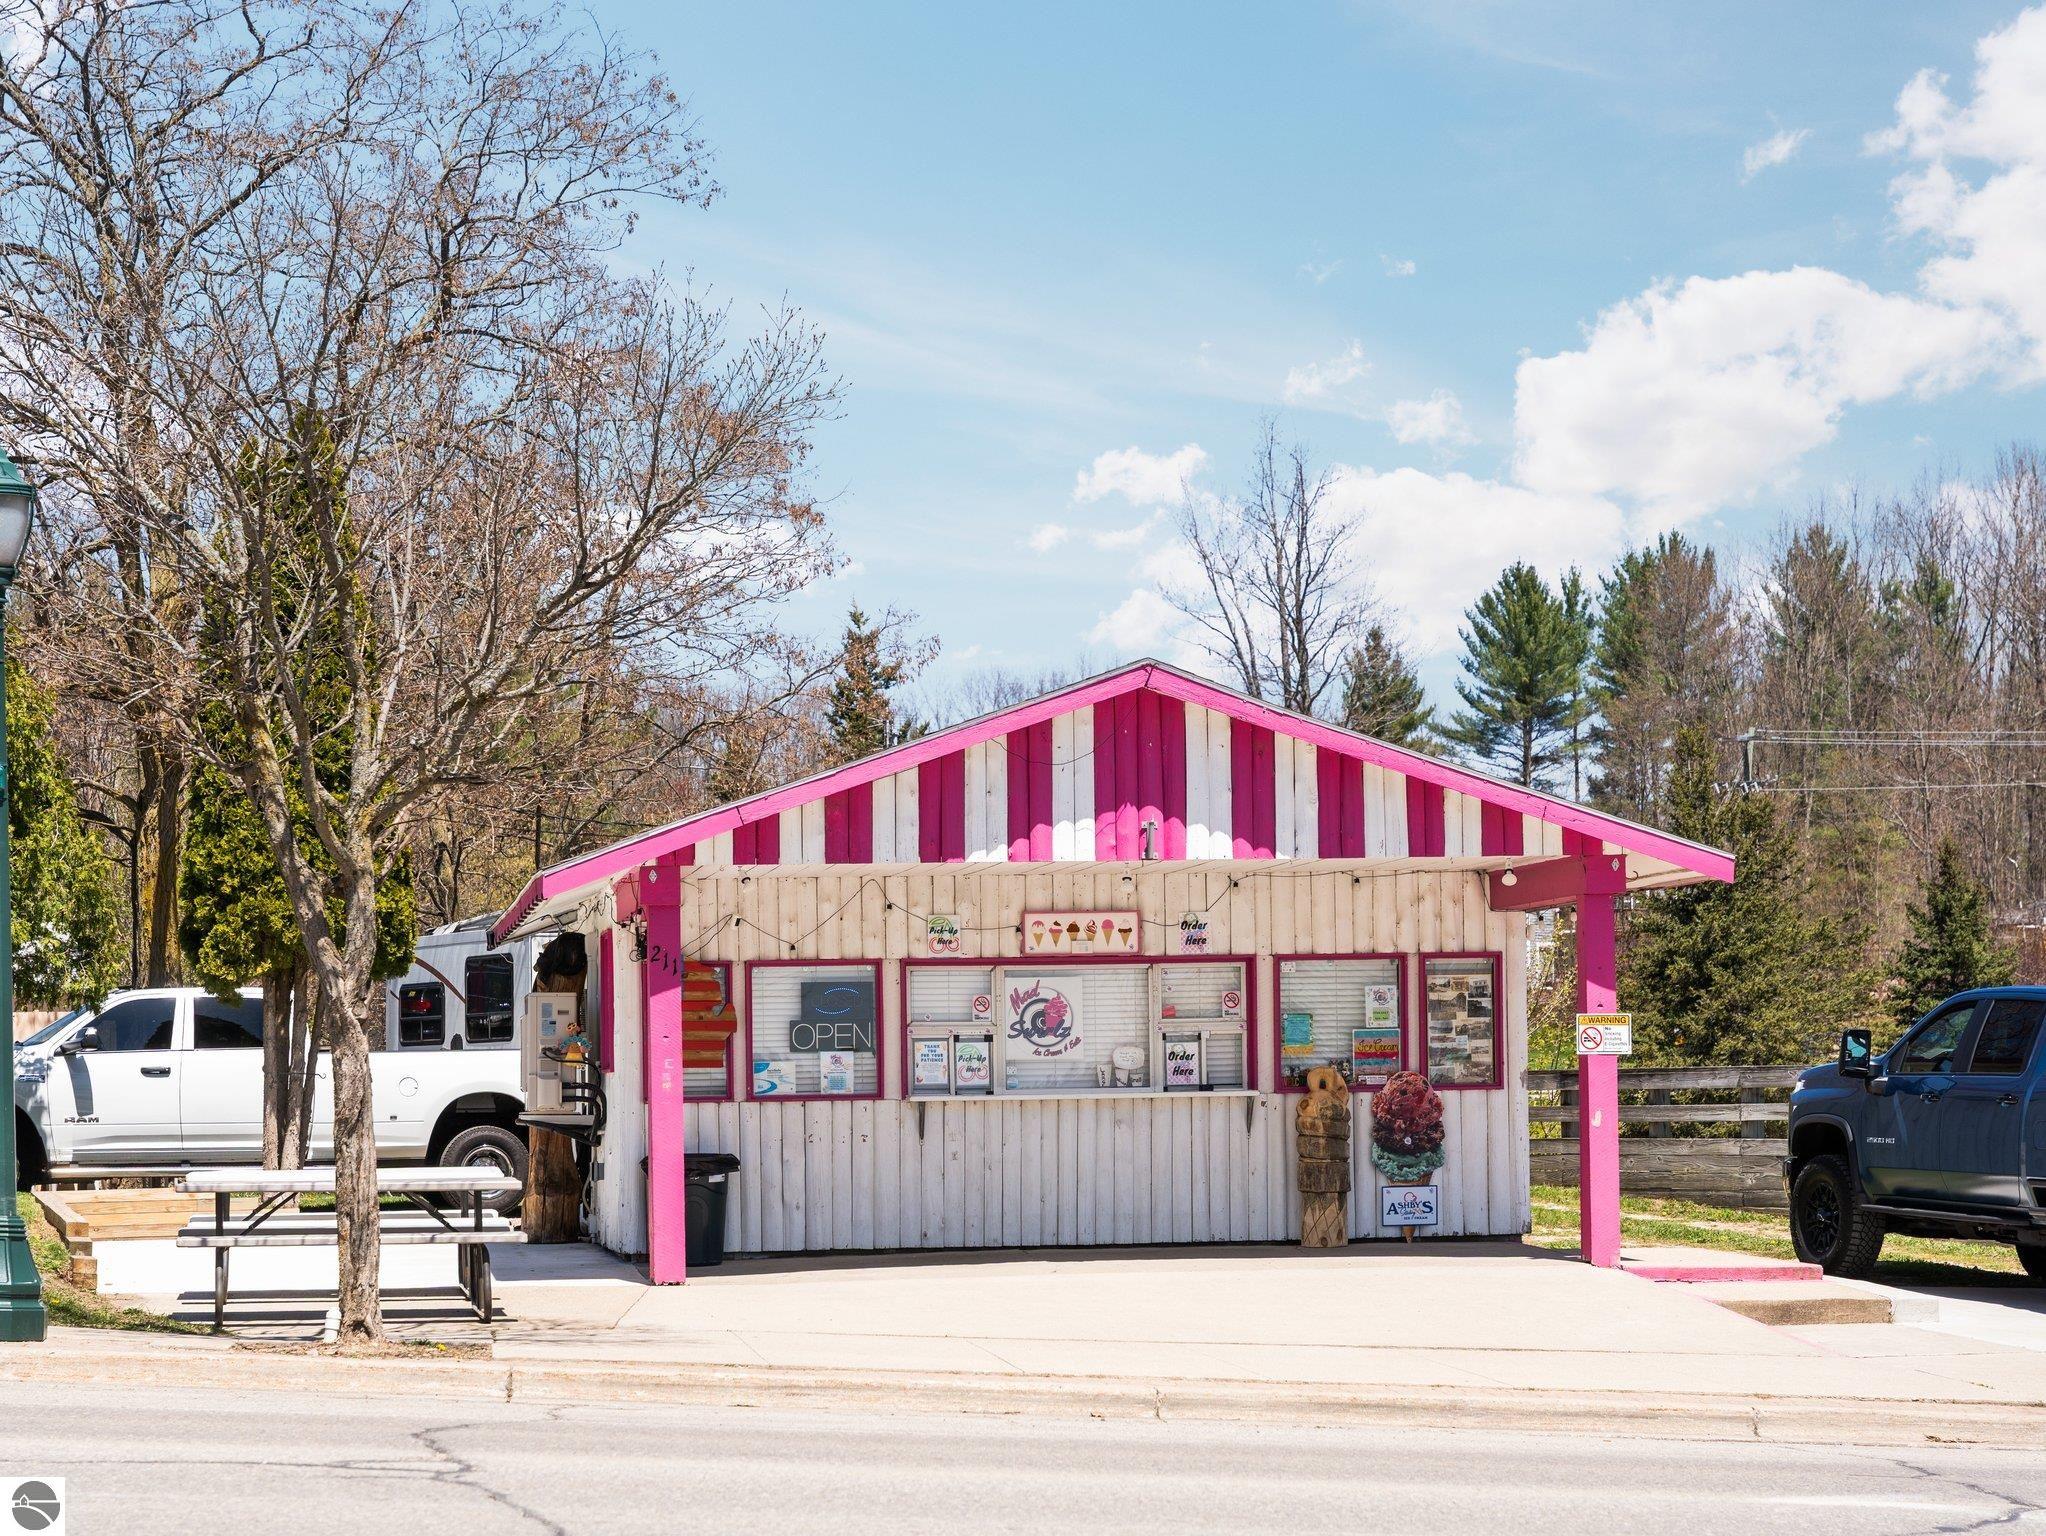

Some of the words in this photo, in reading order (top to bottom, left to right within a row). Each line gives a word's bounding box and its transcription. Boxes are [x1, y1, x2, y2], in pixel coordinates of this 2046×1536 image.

[1181, 920, 1207, 930] Order
[929, 926, 958, 936] Pick-Up
[937, 937, 954, 945] Here
[1185, 935, 1207, 946] Here
[651, 946, 677, 976] 211
[1009, 979, 1041, 1016] Mad
[792, 1022, 872, 1050] OPEN
[1357, 1039, 1373, 1051] Ice
[1373, 1038, 1399, 1051] Cream
[1043, 1048, 1063, 1057] Cream
[1168, 1051, 1195, 1061] Order
[958, 1054, 987, 1063] Pick-Up
[1172, 1066, 1194, 1076] Here
[1386, 1201, 1434, 1216] ASHBY'S
